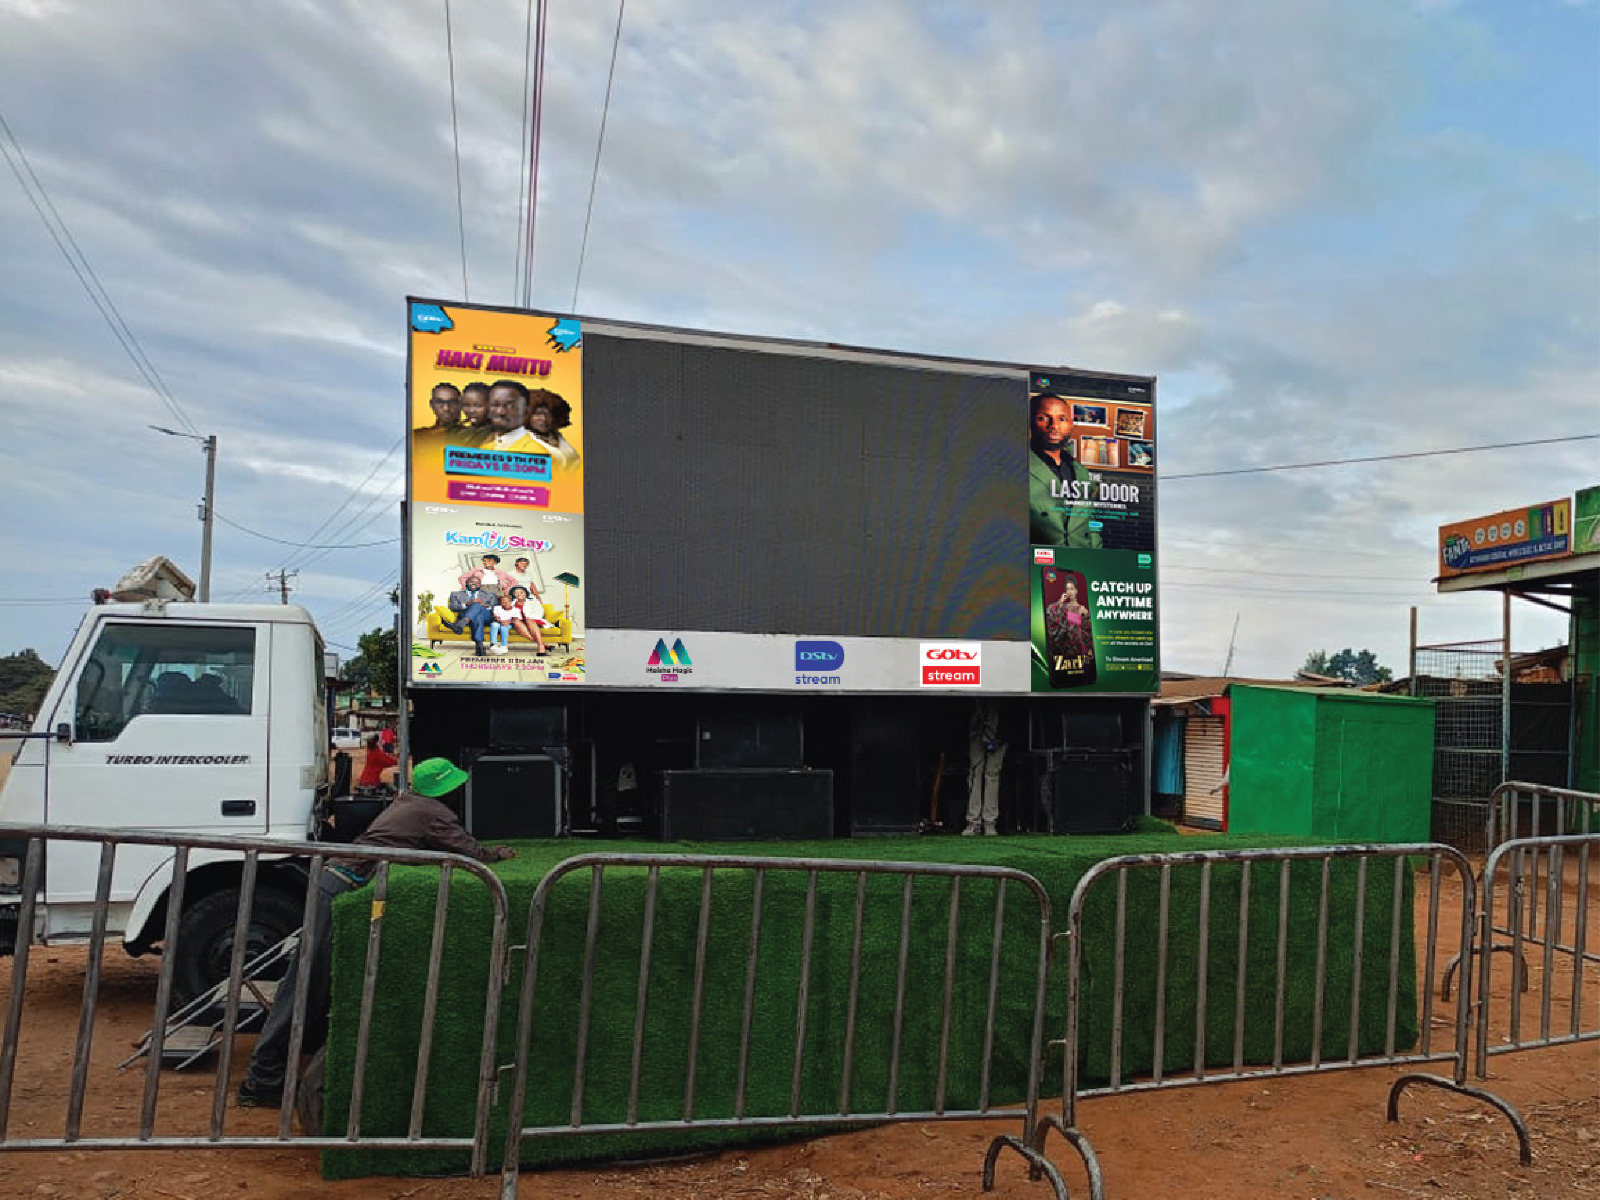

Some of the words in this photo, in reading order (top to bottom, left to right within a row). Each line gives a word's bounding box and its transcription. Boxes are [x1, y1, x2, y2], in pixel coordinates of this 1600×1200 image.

[436, 349, 483, 370] HAKI
[486, 355, 552, 376] MWITU
[1051, 479, 1091, 499] LAST
[1099, 483, 1140, 503] DOOR
[1091, 581, 1134, 593] CATCH
[1136, 583, 1152, 594] UP
[1096, 596, 1153, 608] ANYTIME
[1096, 610, 1154, 620] ANYWHERE
[800, 651, 838, 661] DStv
[926, 649, 977, 661] GOtv
[795, 674, 840, 685] stream
[928, 670, 975, 681] stream
[105, 755, 154, 765] TURBO
[155, 755, 249, 765] INTERCOOLER
